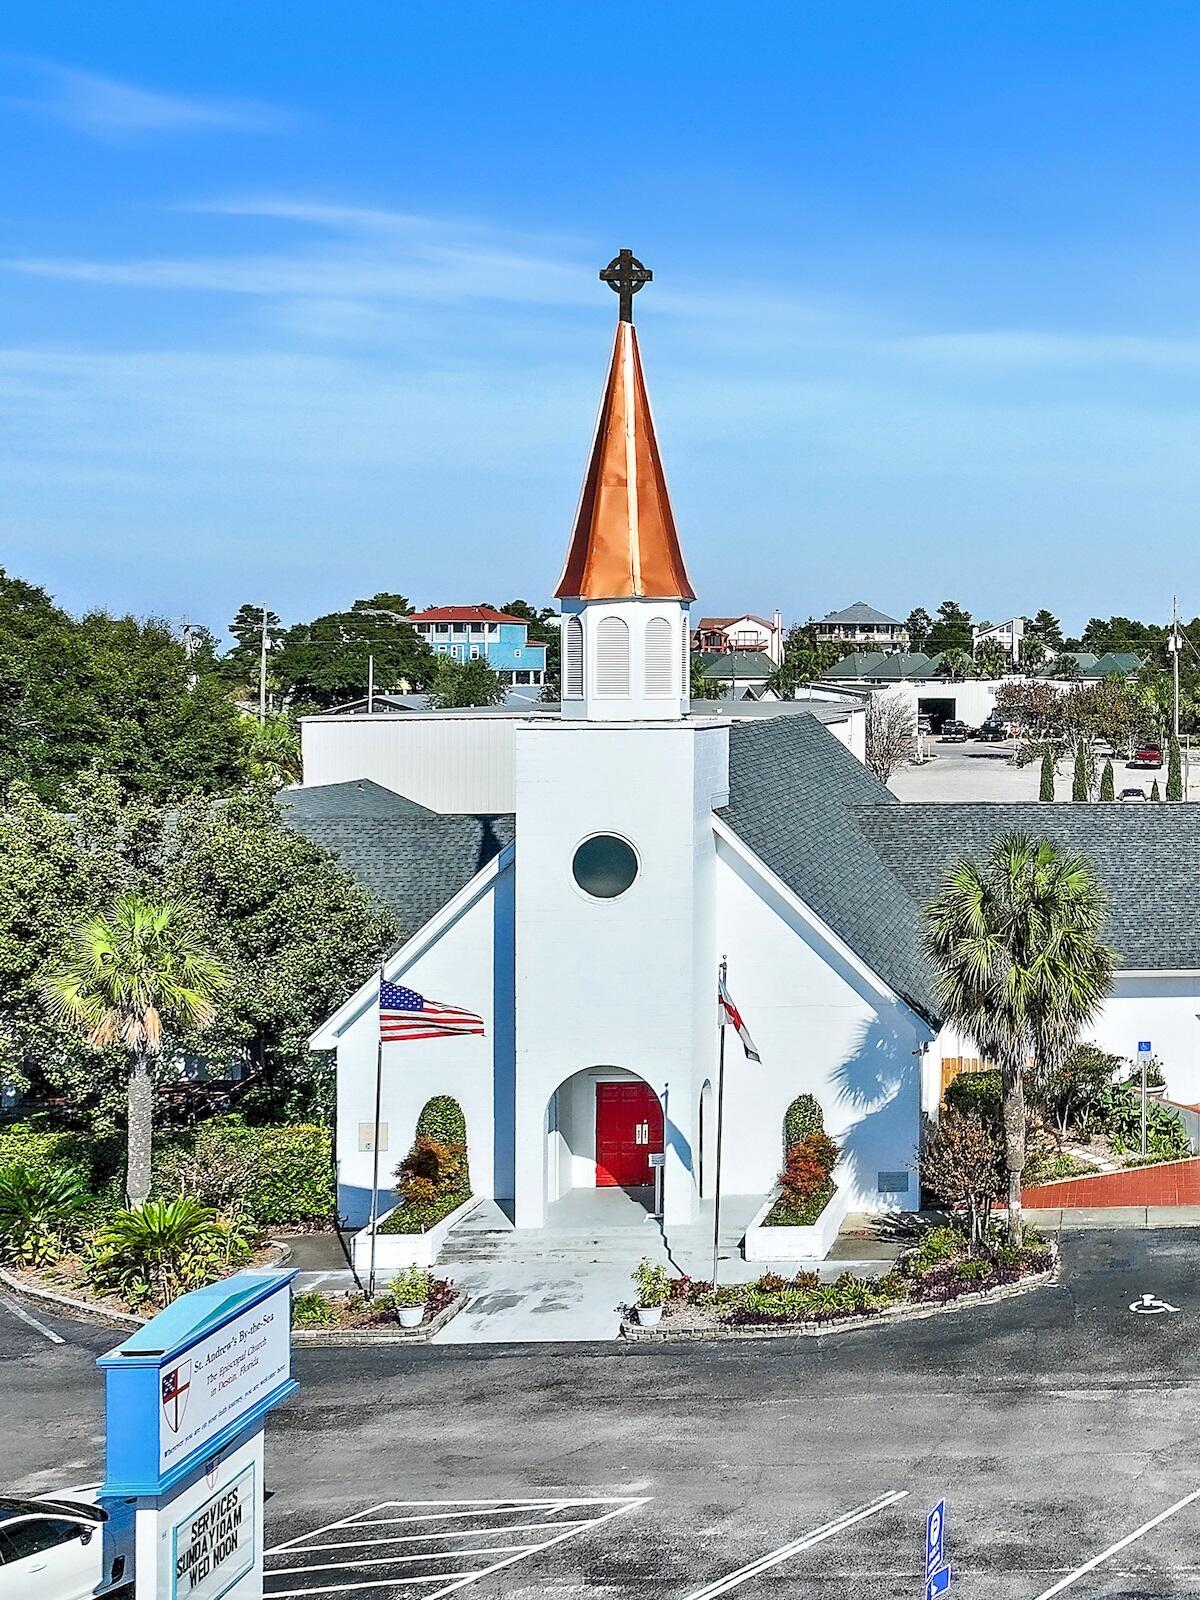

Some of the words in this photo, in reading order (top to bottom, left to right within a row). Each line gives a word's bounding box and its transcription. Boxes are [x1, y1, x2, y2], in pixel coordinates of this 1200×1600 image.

[194, 1360, 203, 1373] St.
[205, 1336, 237, 1366] Andrew's
[239, 1313, 274, 1343] By-the-Sea
[207, 1373, 218, 1385] The
[219, 1349, 247, 1378] Episcopal
[247, 1336, 268, 1356] Church
[240, 1356, 259, 1376] Florida
[191, 1486, 238, 1543] SERVICES
[189, 1555, 210, 1589] WED
[213, 1529, 238, 1569] NOON
